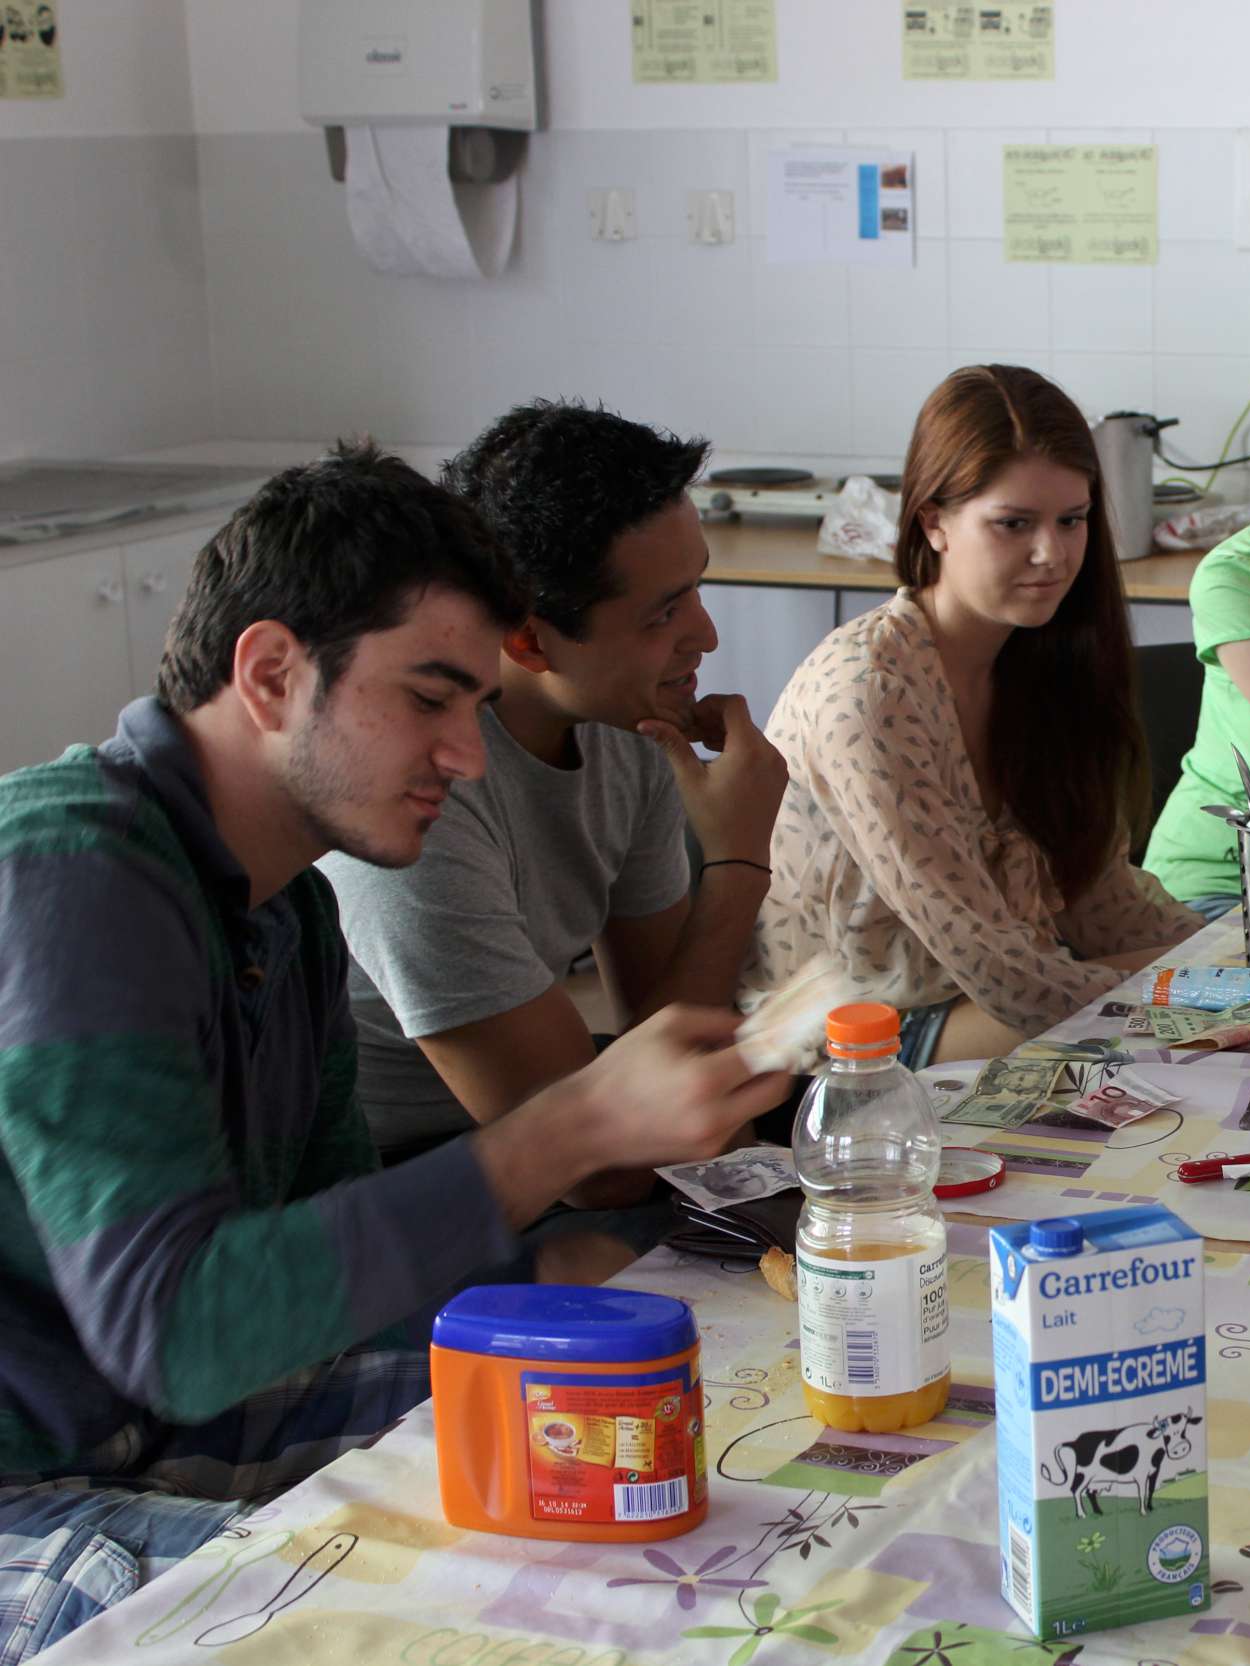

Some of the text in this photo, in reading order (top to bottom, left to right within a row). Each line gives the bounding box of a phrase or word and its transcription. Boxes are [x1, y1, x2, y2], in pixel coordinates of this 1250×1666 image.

[1158, 1023, 1175, 1036] 200
[1089, 1086, 1127, 1103] 10
[1039, 1256, 1196, 1300] Carrefour
[1042, 1311, 1077, 1330] Lait
[1040, 1340, 1198, 1403] DEMI-ÉCRÉMÉ
